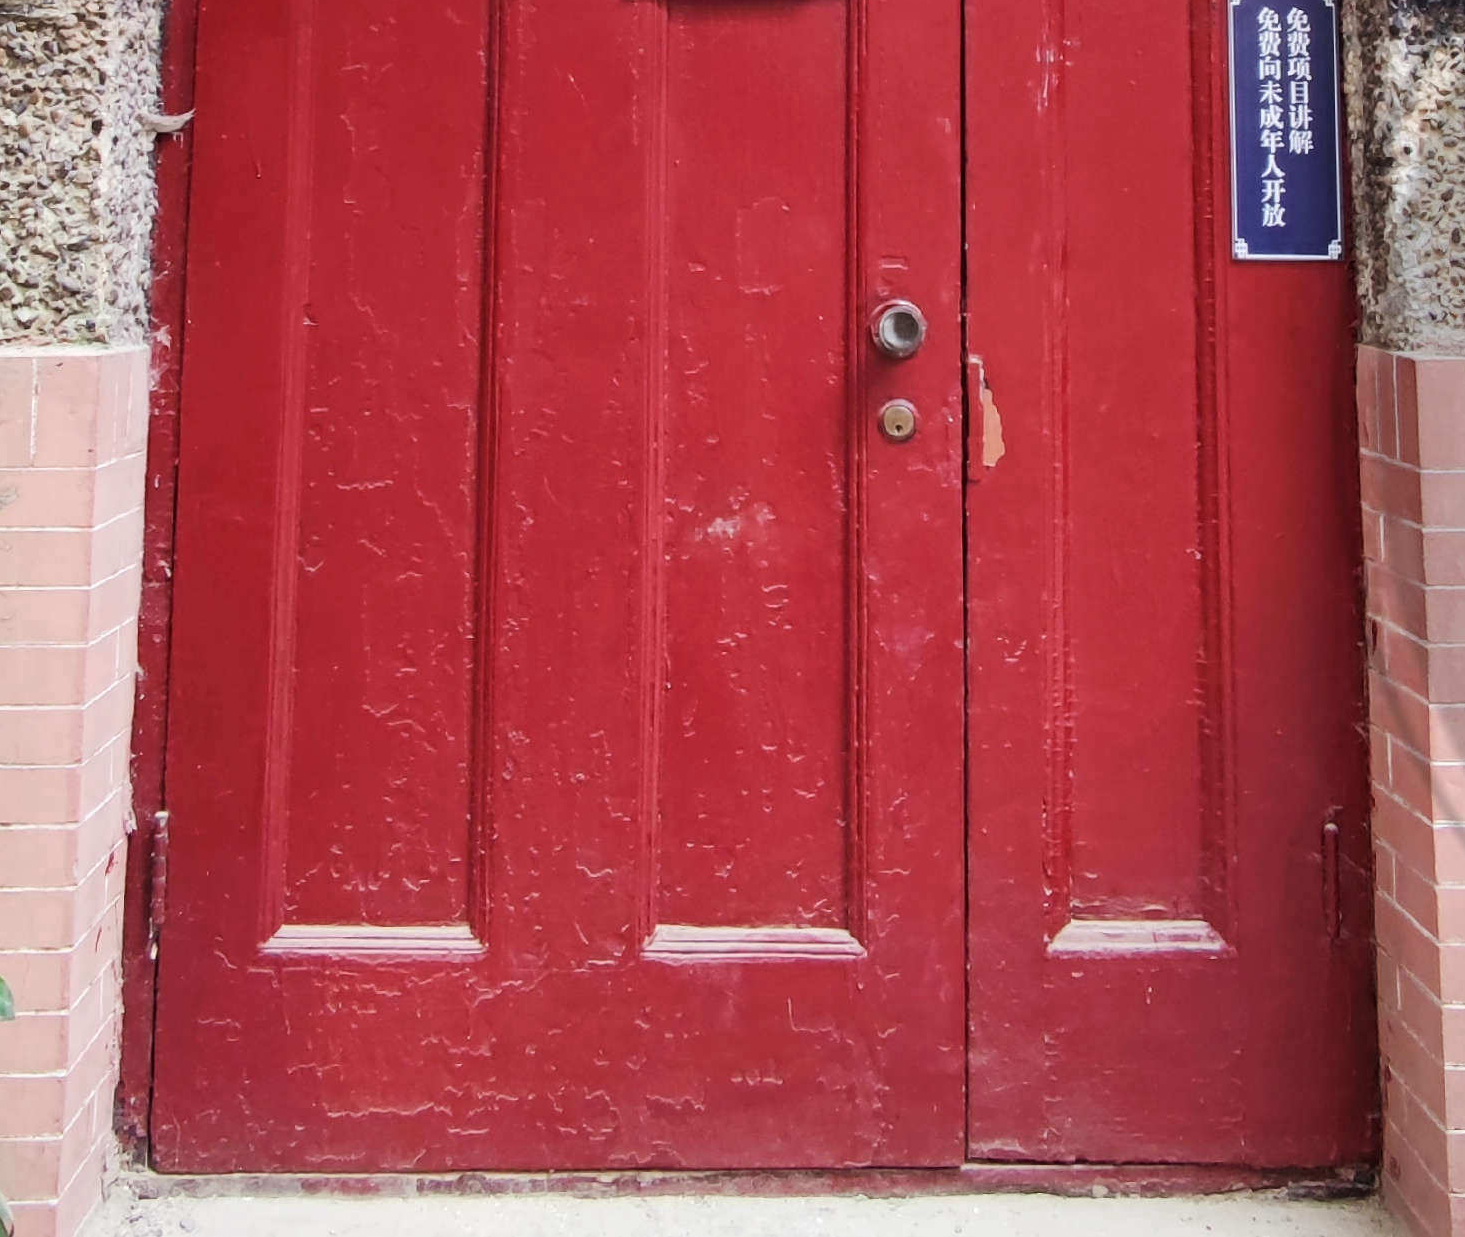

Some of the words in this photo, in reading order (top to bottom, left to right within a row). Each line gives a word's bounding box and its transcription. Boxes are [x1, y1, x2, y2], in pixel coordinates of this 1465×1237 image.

[1258, 7, 1286, 227] 免费向未成年人开放
[1287, 7, 1314, 155] 免费项目讲解
